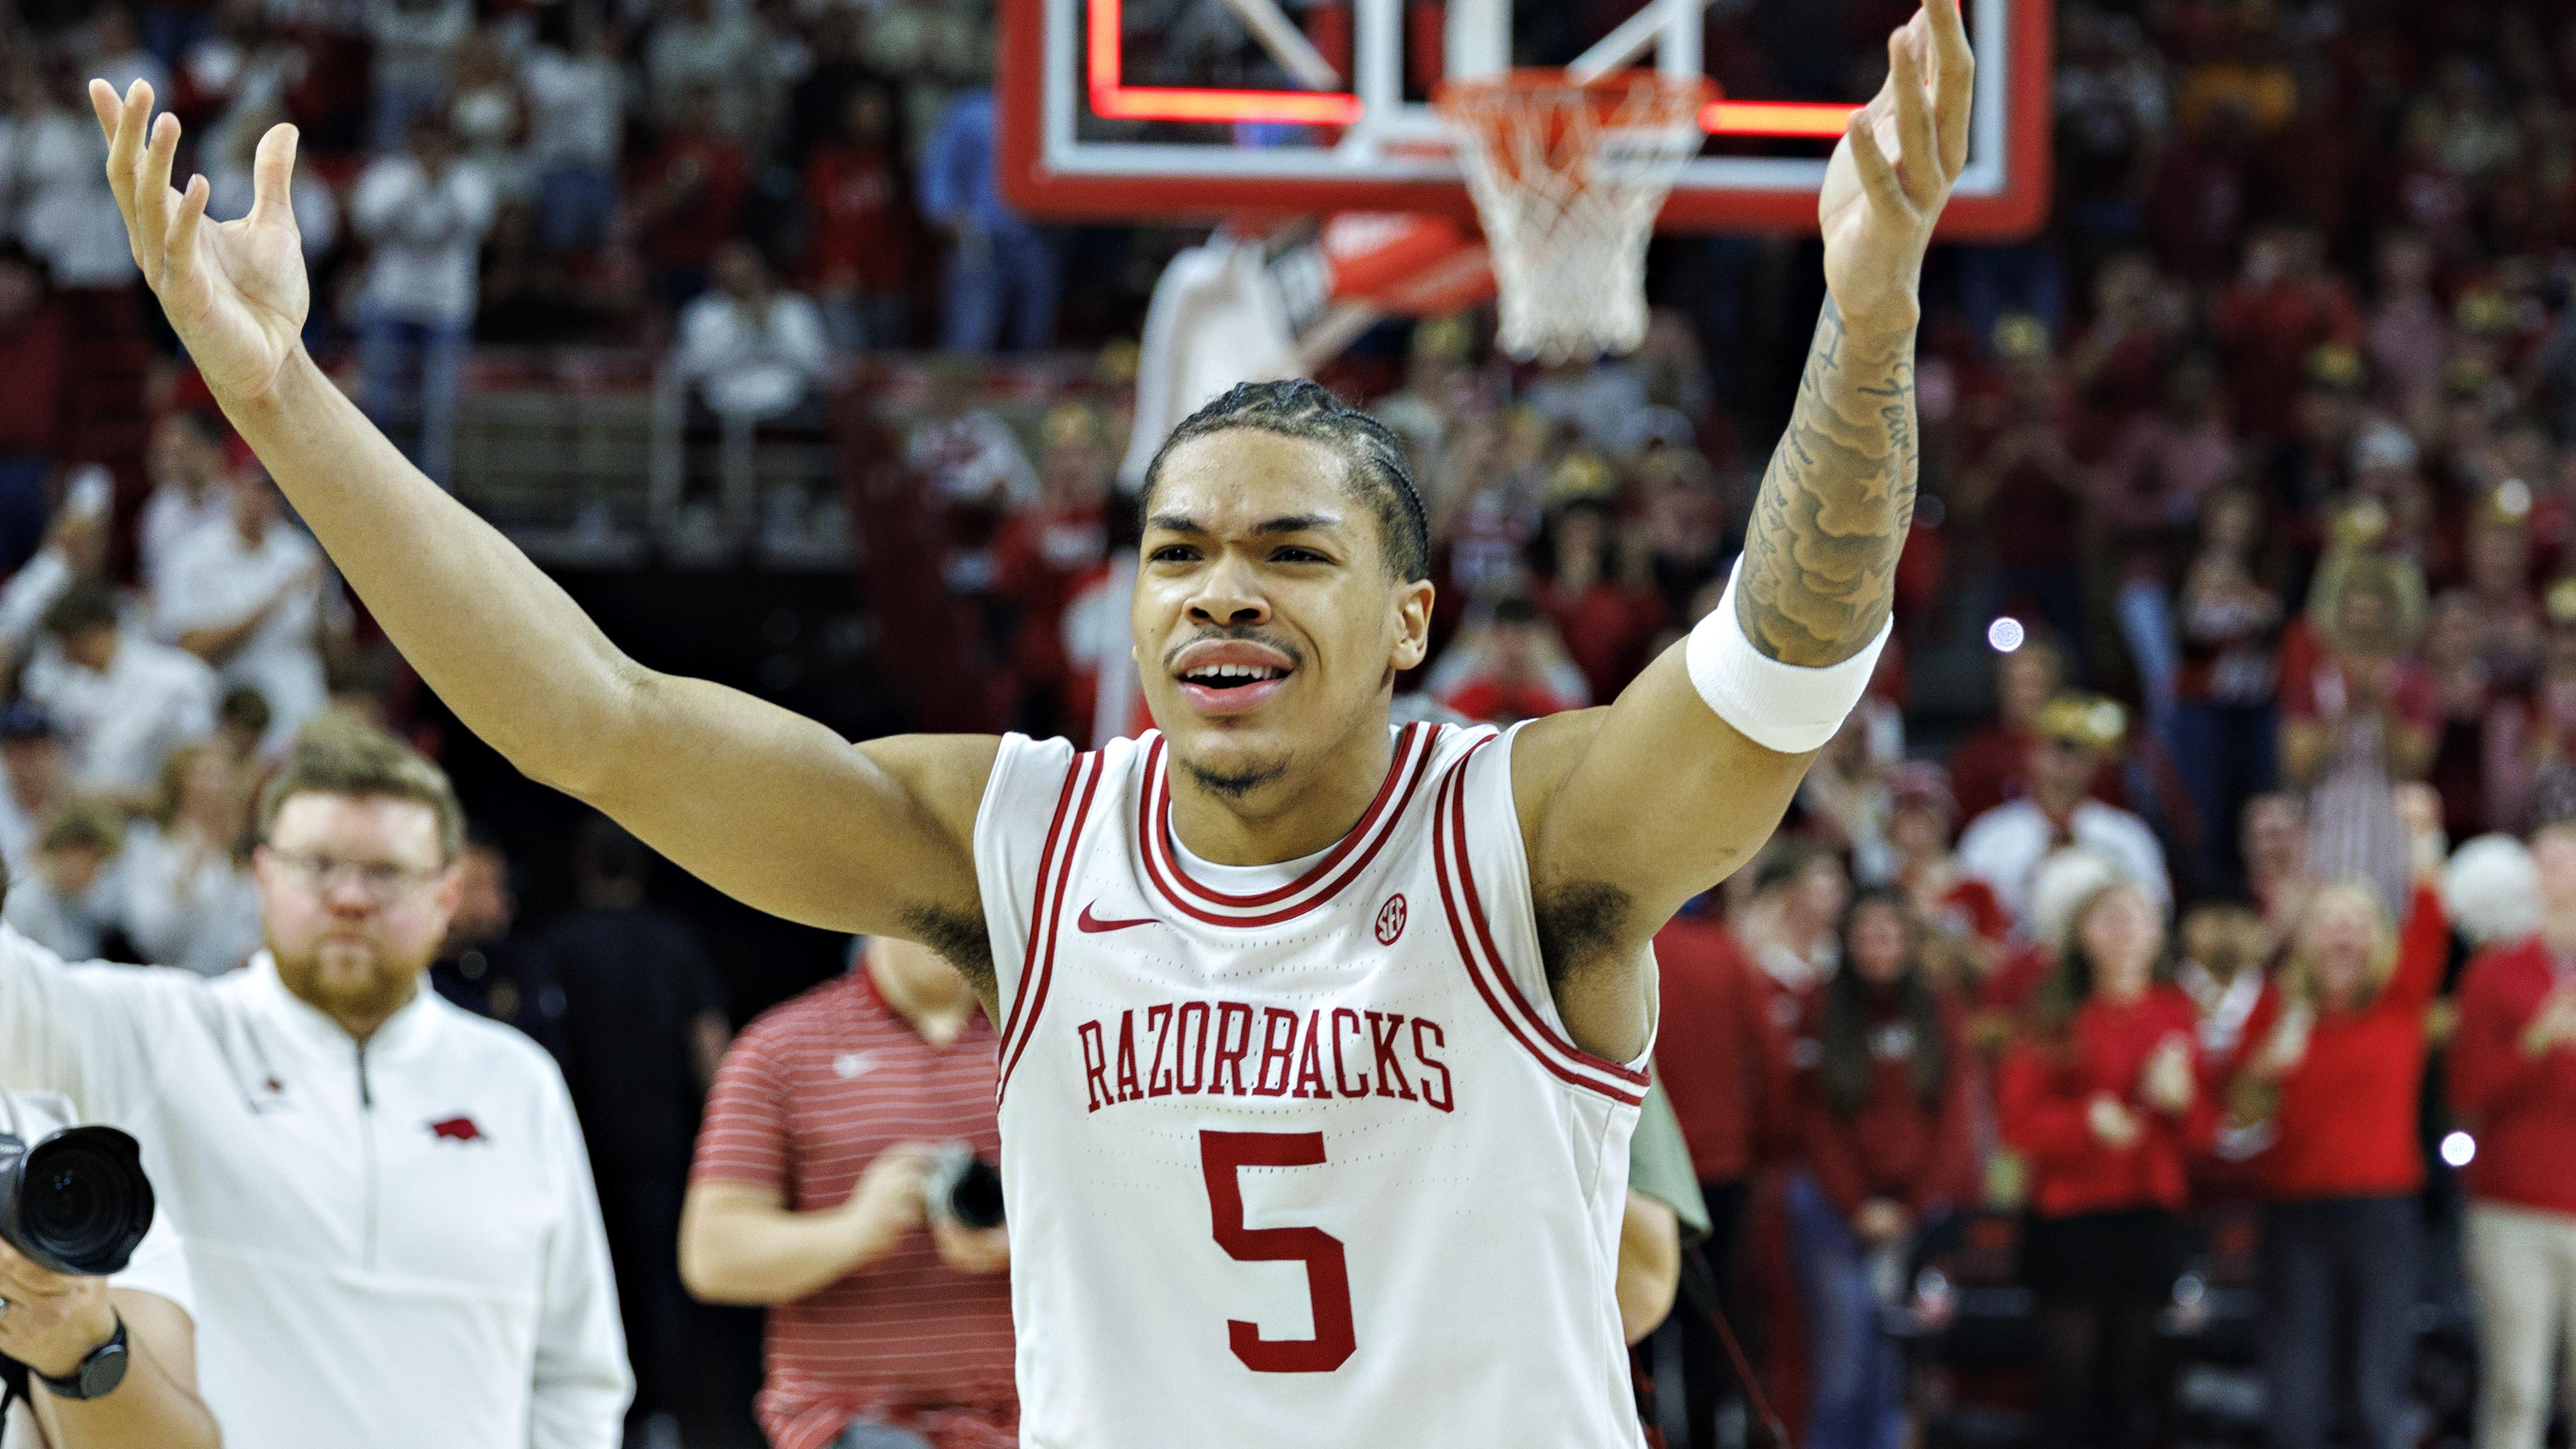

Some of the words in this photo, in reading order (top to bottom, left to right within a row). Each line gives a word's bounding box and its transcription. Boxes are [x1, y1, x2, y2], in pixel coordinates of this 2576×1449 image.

[1377, 896, 1405, 942] SEC
[1078, 1001, 1454, 1113] RAZORBACKS
[1199, 1129, 1356, 1372] 5
